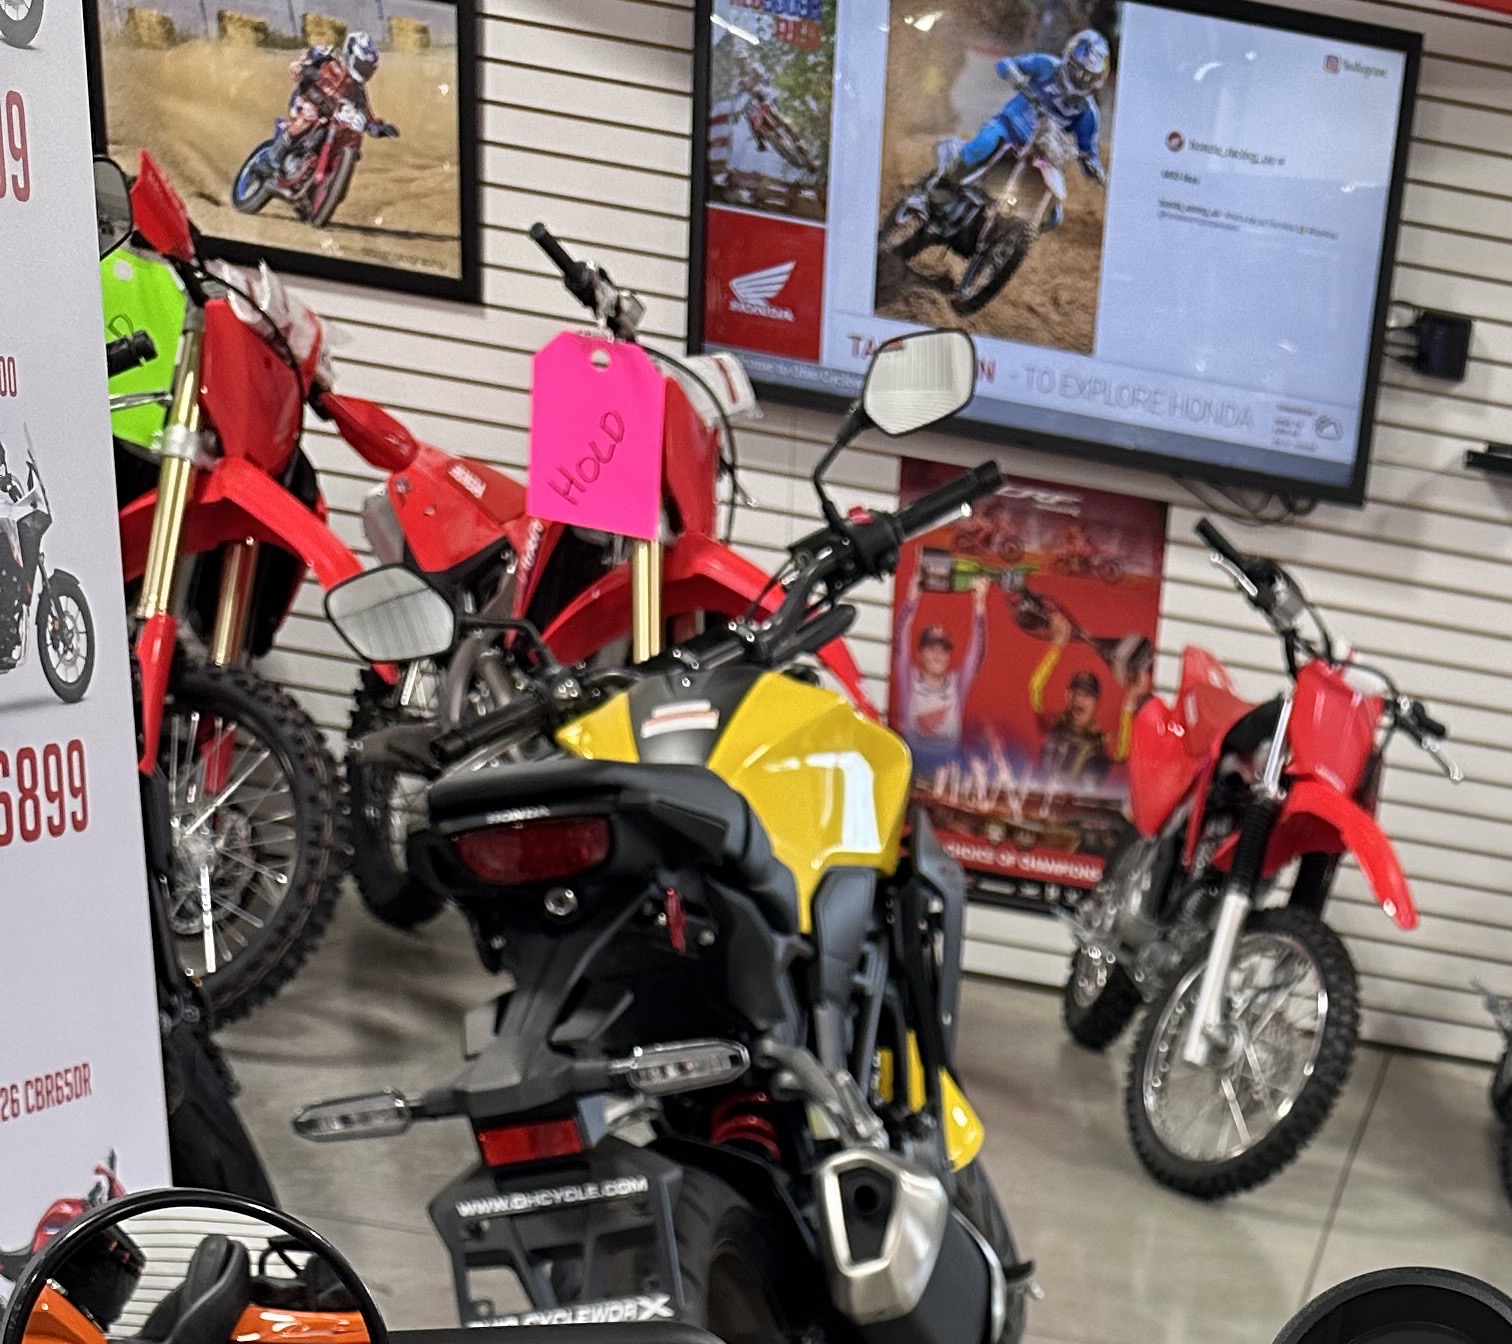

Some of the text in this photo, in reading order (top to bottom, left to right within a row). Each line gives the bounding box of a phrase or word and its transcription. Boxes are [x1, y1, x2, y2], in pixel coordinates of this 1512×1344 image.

[0, 90, 31, 202] 9
[848, 333, 879, 359] TA
[1023, 366, 1056, 394] TO
[1060, 372, 1166, 416] EXPLORE
[1167, 388, 1255, 430] HONDA
[547, 411, 625, 505] HOLD
[25, 1063, 92, 1114] CBR650R
